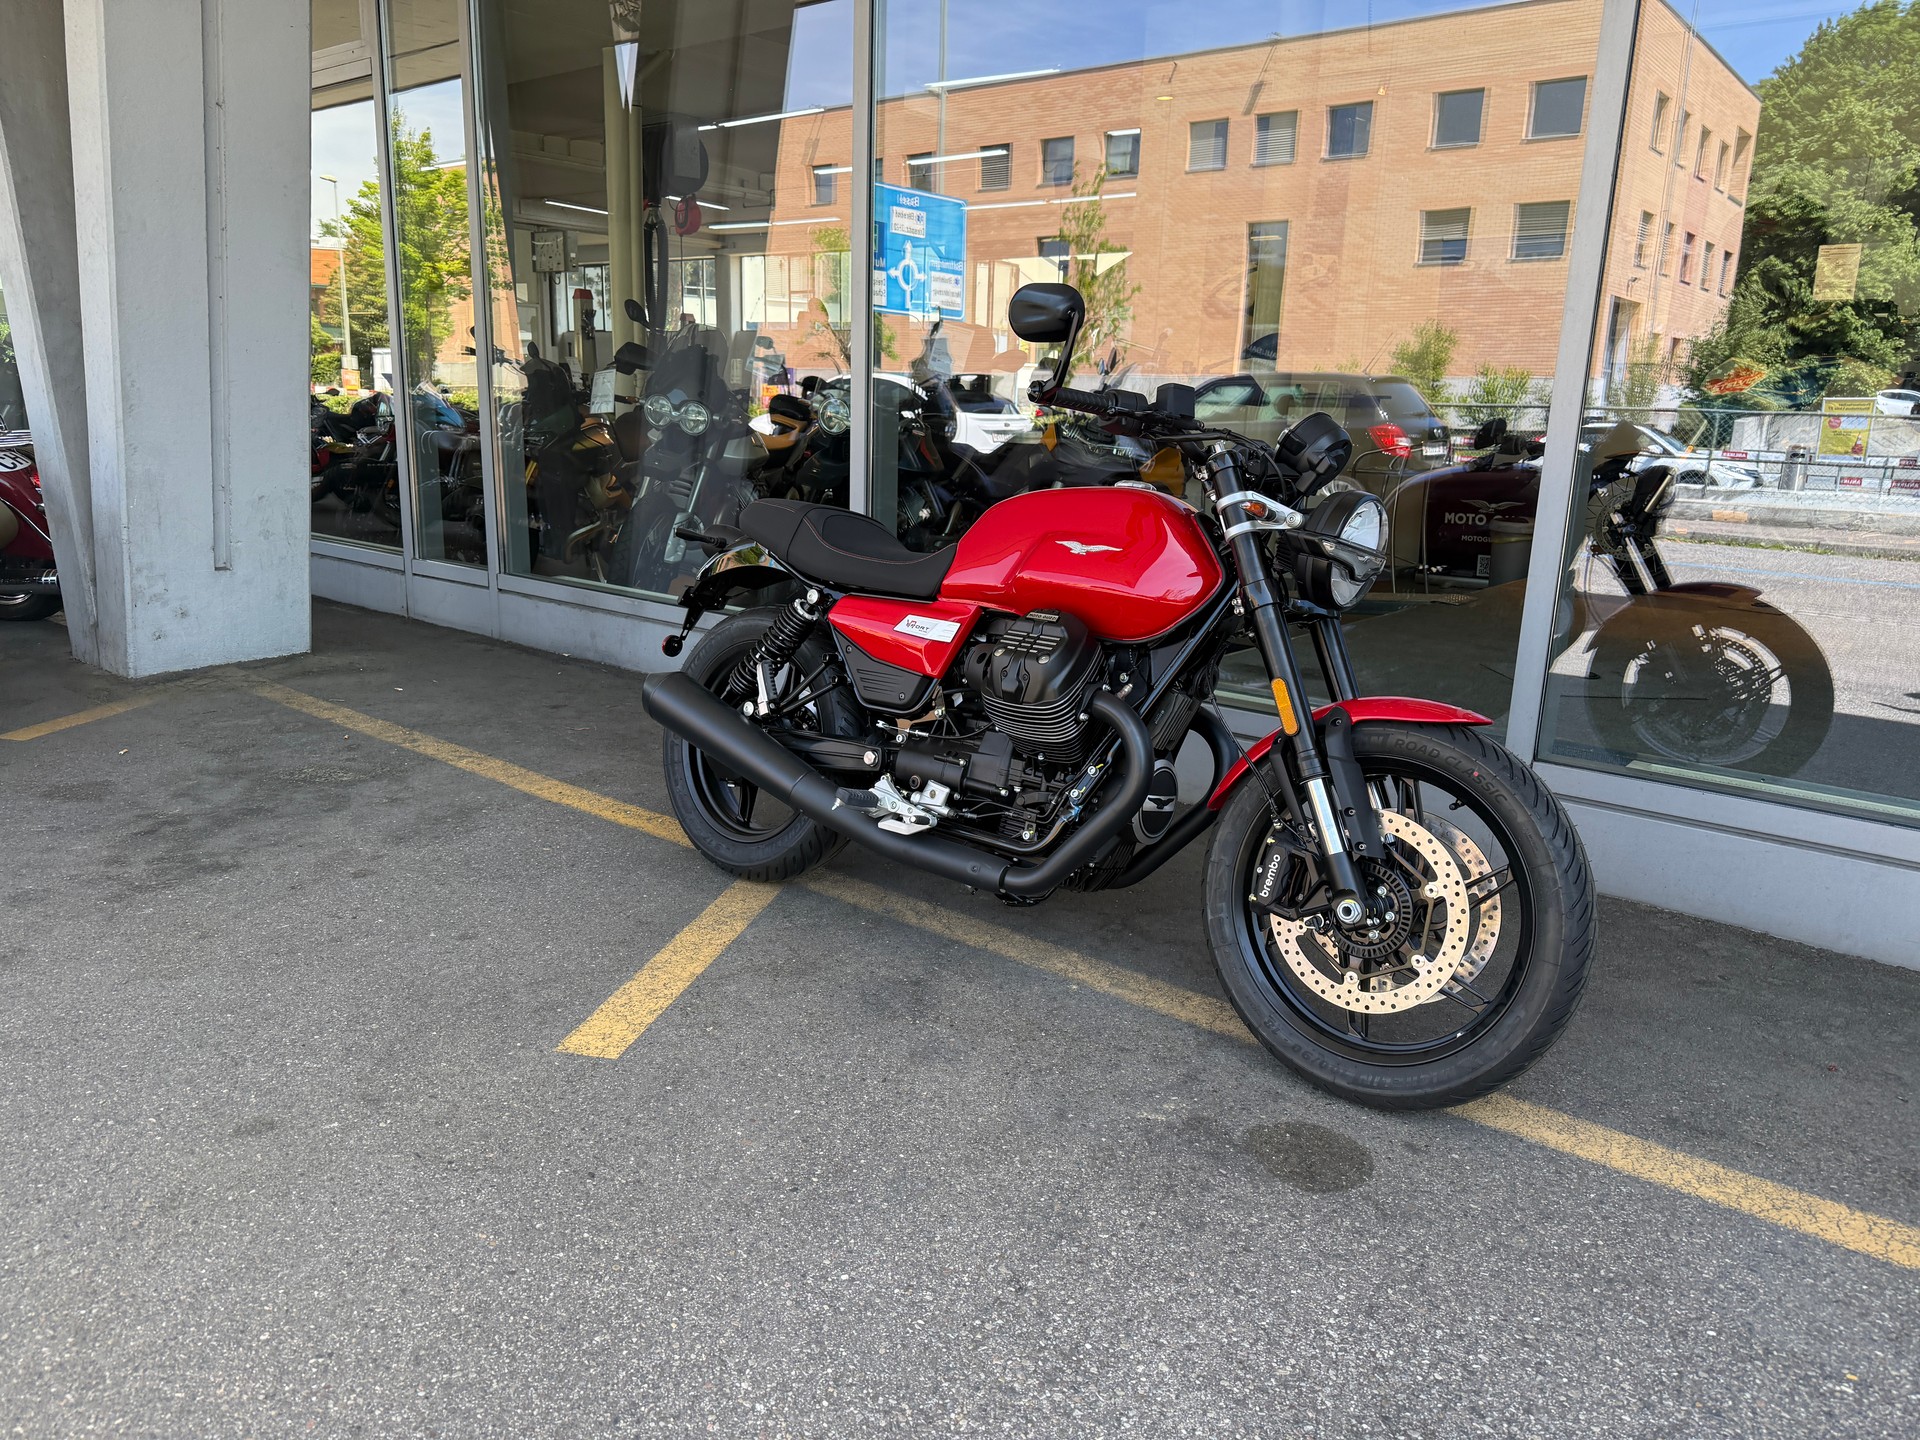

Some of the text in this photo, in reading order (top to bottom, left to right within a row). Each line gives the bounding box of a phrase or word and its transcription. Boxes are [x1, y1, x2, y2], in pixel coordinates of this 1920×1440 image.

[0, 452, 29, 470] CH
[1444, 512, 1487, 526] MOTO
[1393, 738, 1441, 759] ROAD
[1444, 755, 1509, 804] CLASSIC
[1259, 854, 1281, 898] brembo
